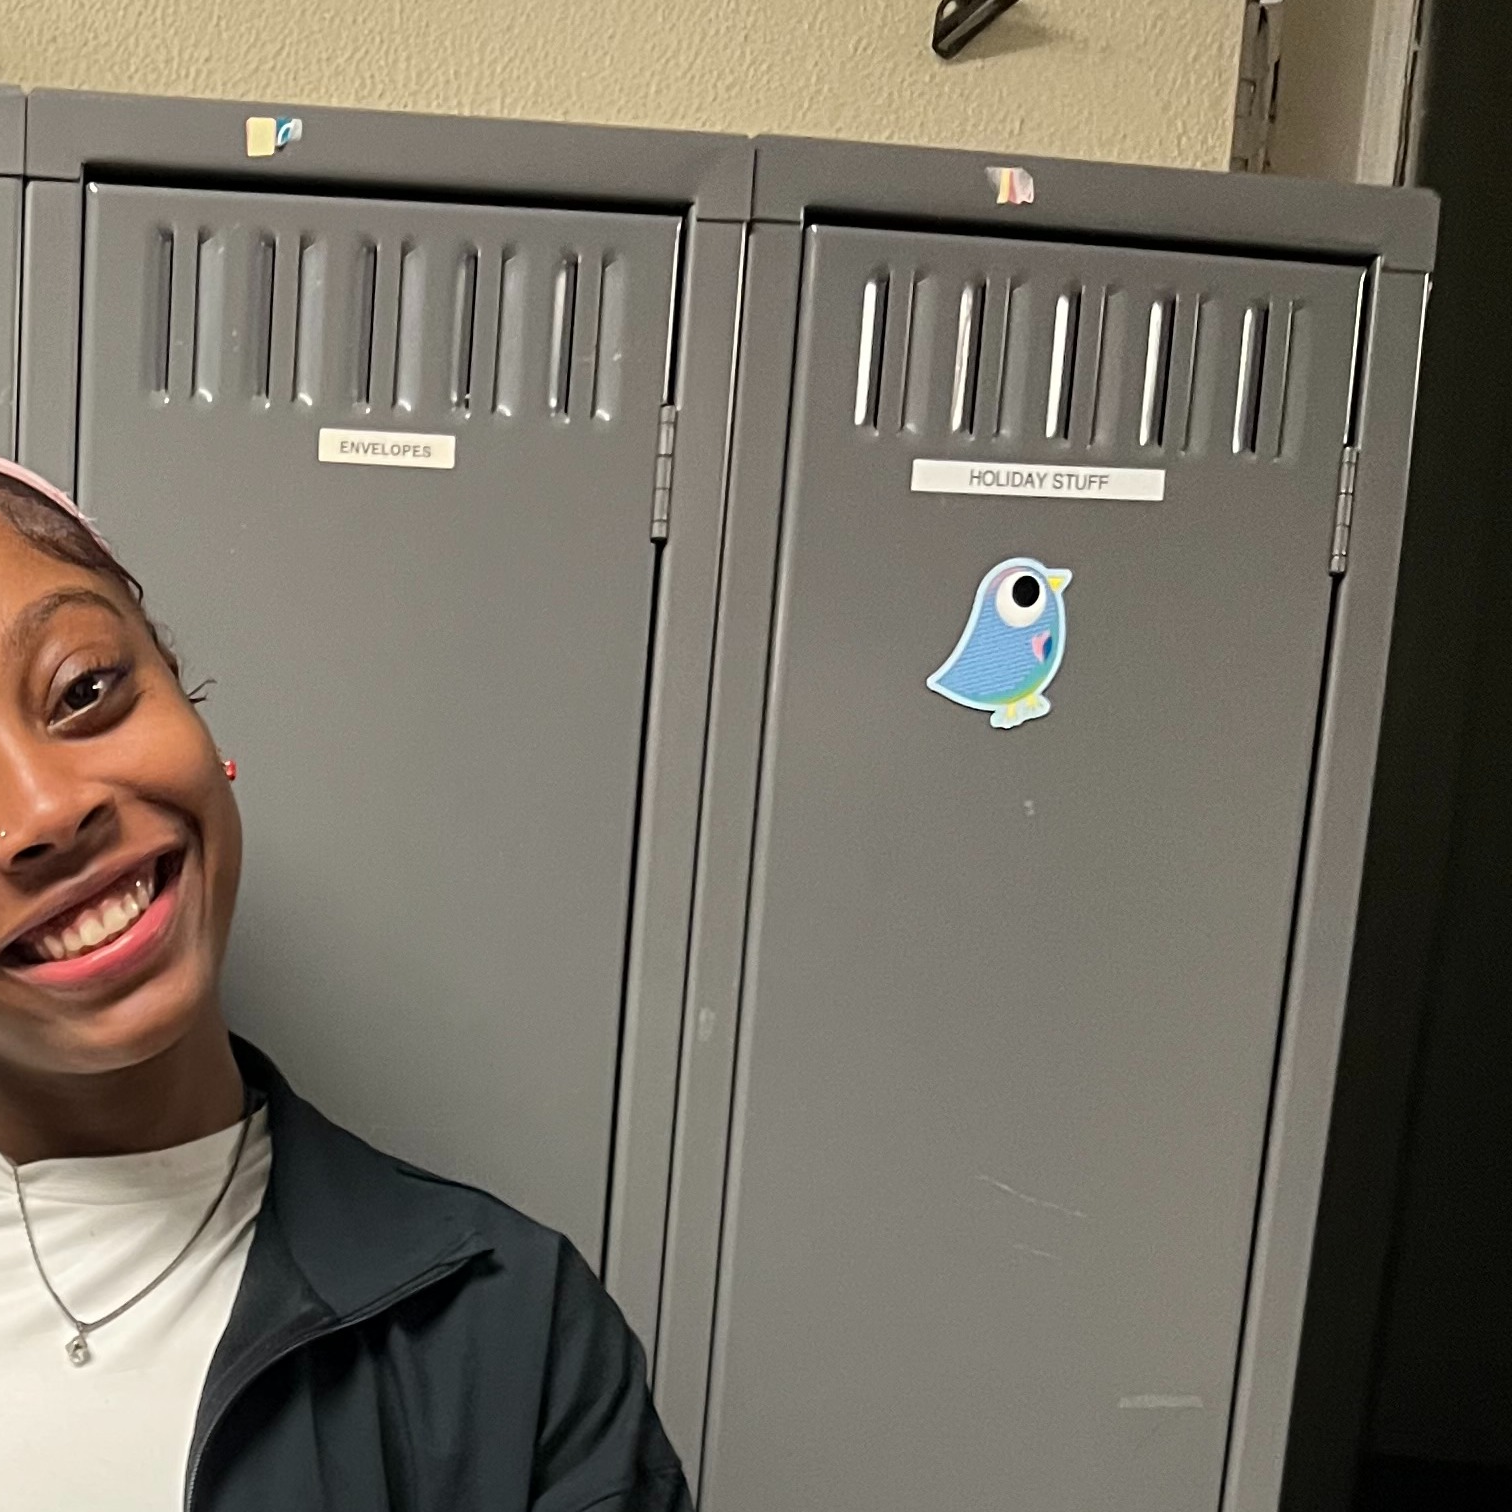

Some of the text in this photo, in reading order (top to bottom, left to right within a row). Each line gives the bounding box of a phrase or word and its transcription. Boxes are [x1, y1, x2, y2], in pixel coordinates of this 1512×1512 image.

[339, 440, 432, 458] ENVELOPES
[968, 469, 1110, 490] HOLIDAY STUFF
